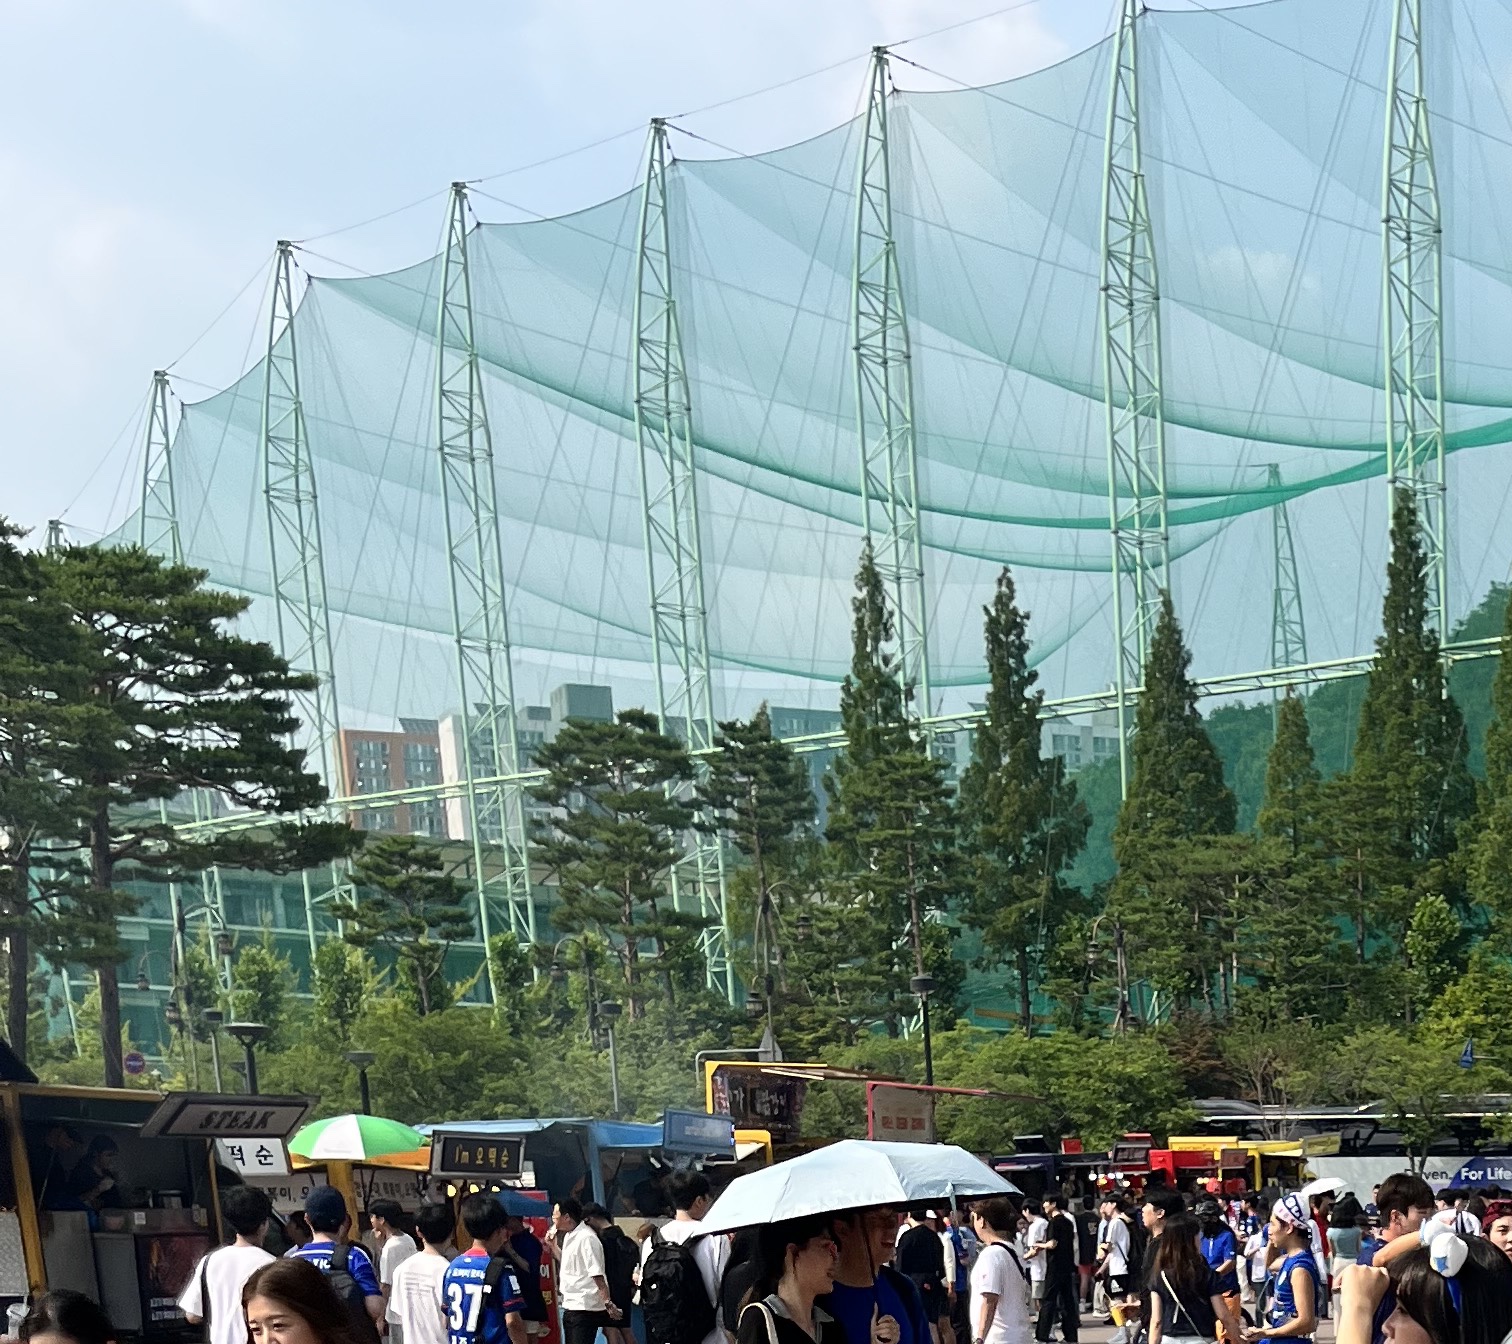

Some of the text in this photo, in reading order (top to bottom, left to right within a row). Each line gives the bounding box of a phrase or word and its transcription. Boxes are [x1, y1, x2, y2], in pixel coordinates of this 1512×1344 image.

[199, 1110, 276, 1129] STEAK
[1461, 1167, 1484, 1180] For
[448, 1283, 486, 1333] 37
